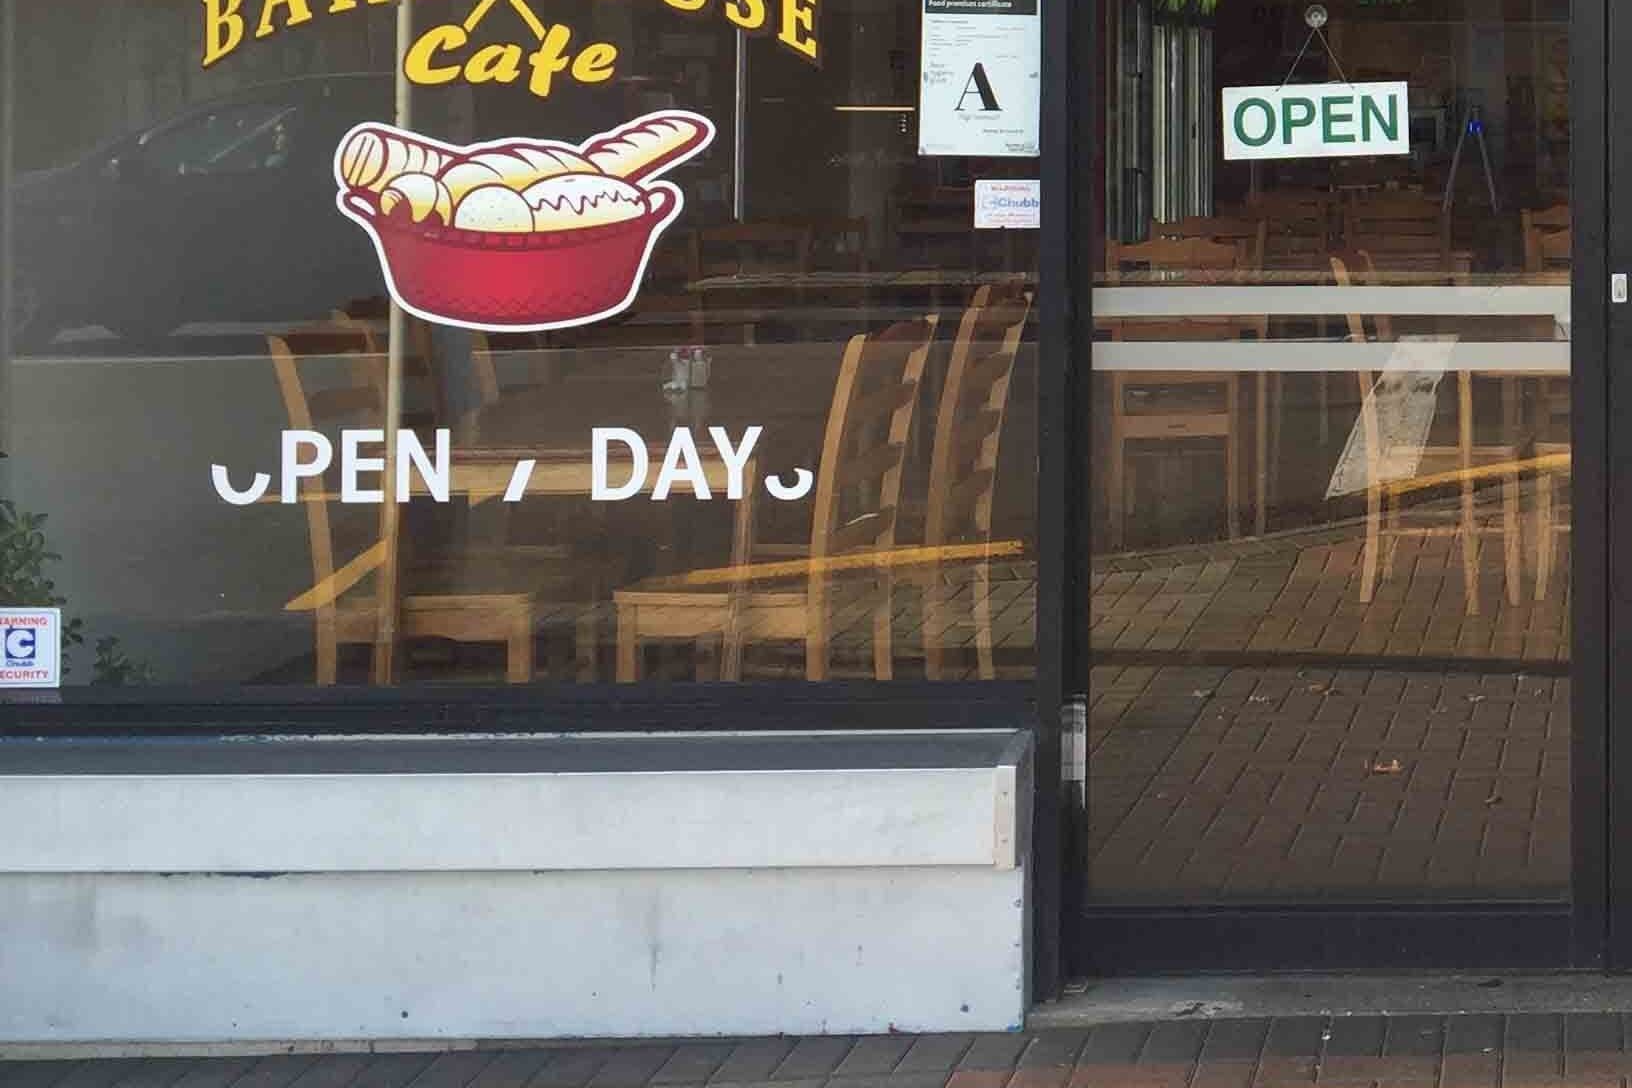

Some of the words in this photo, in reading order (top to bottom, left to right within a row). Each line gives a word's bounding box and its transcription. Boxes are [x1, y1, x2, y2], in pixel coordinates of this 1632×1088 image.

[403, 23, 618, 97] Cafe
[953, 61, 1004, 112] A
[1233, 93, 1399, 148] OPEN
[0, 670, 49, 680] ECURITY
